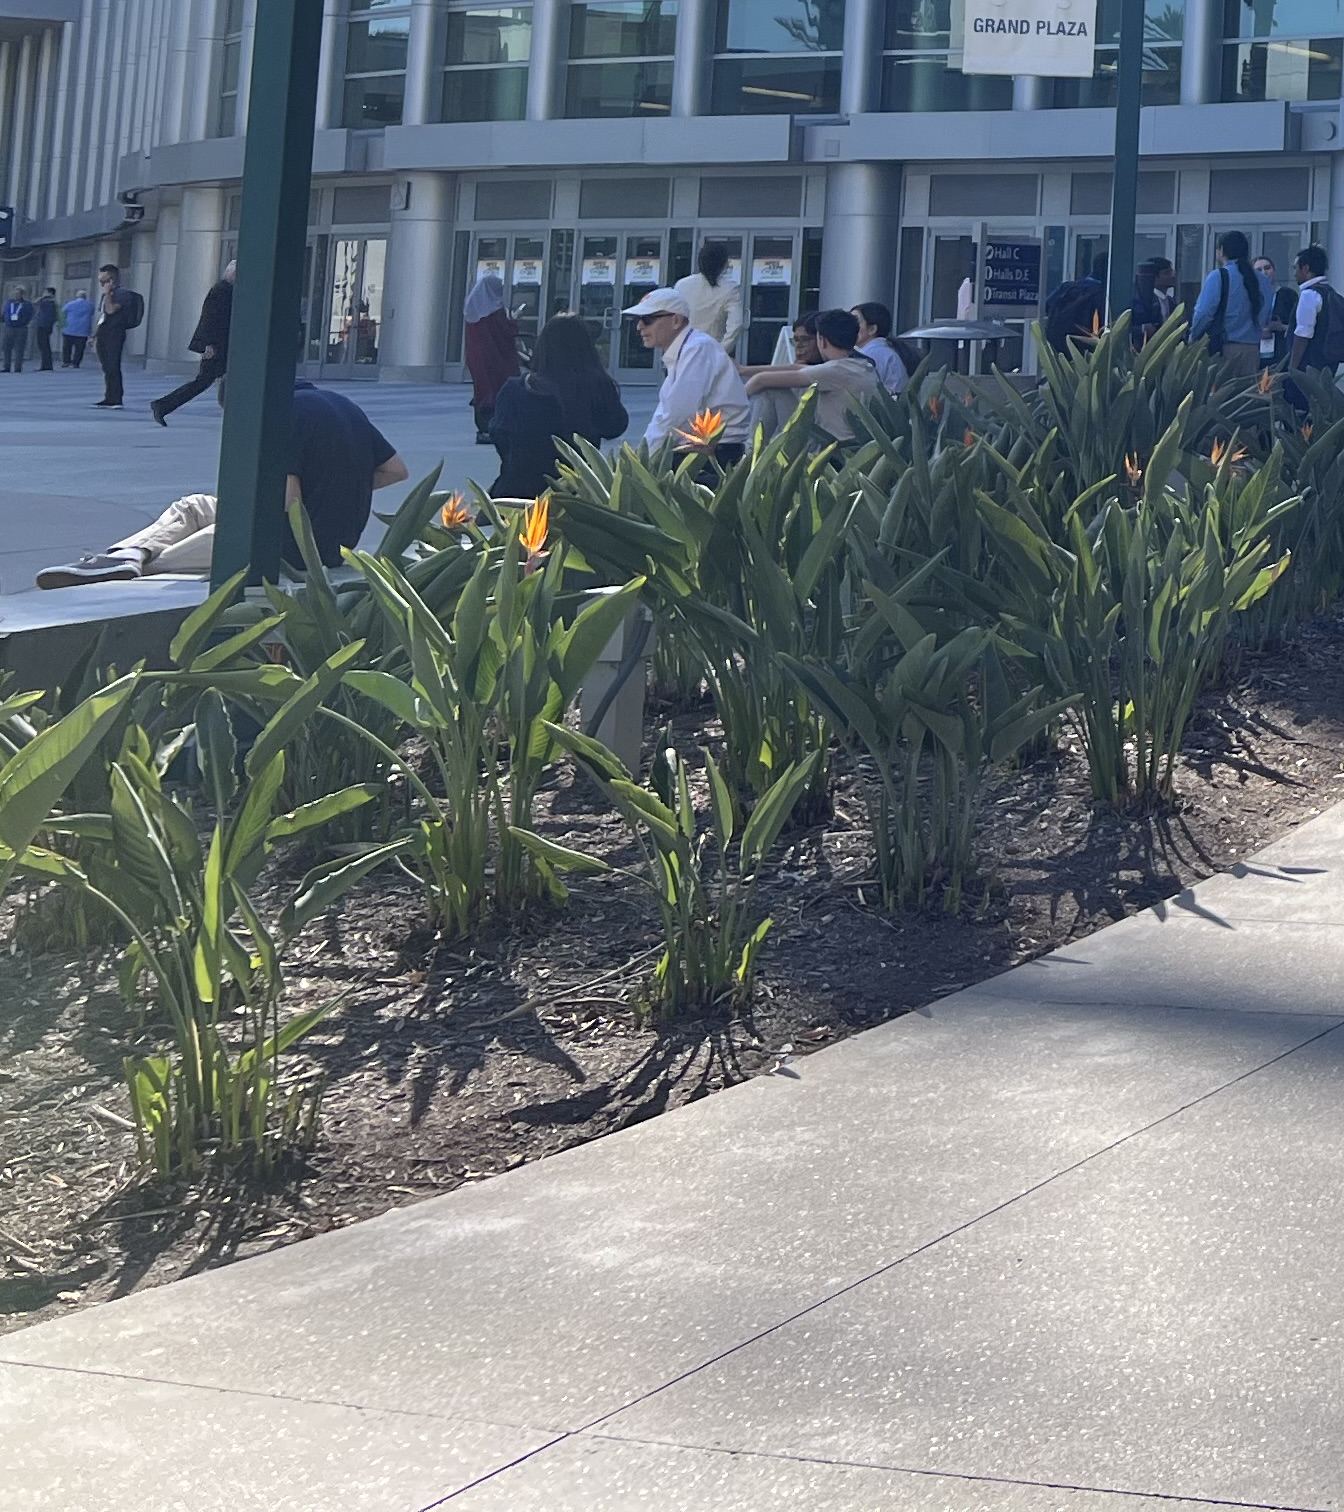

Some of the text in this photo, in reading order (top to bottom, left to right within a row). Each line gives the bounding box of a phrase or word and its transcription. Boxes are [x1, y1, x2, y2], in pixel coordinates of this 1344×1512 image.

[973, 17, 1089, 37] GRAND PLAZA
[994, 246, 1020, 260] Hall C
